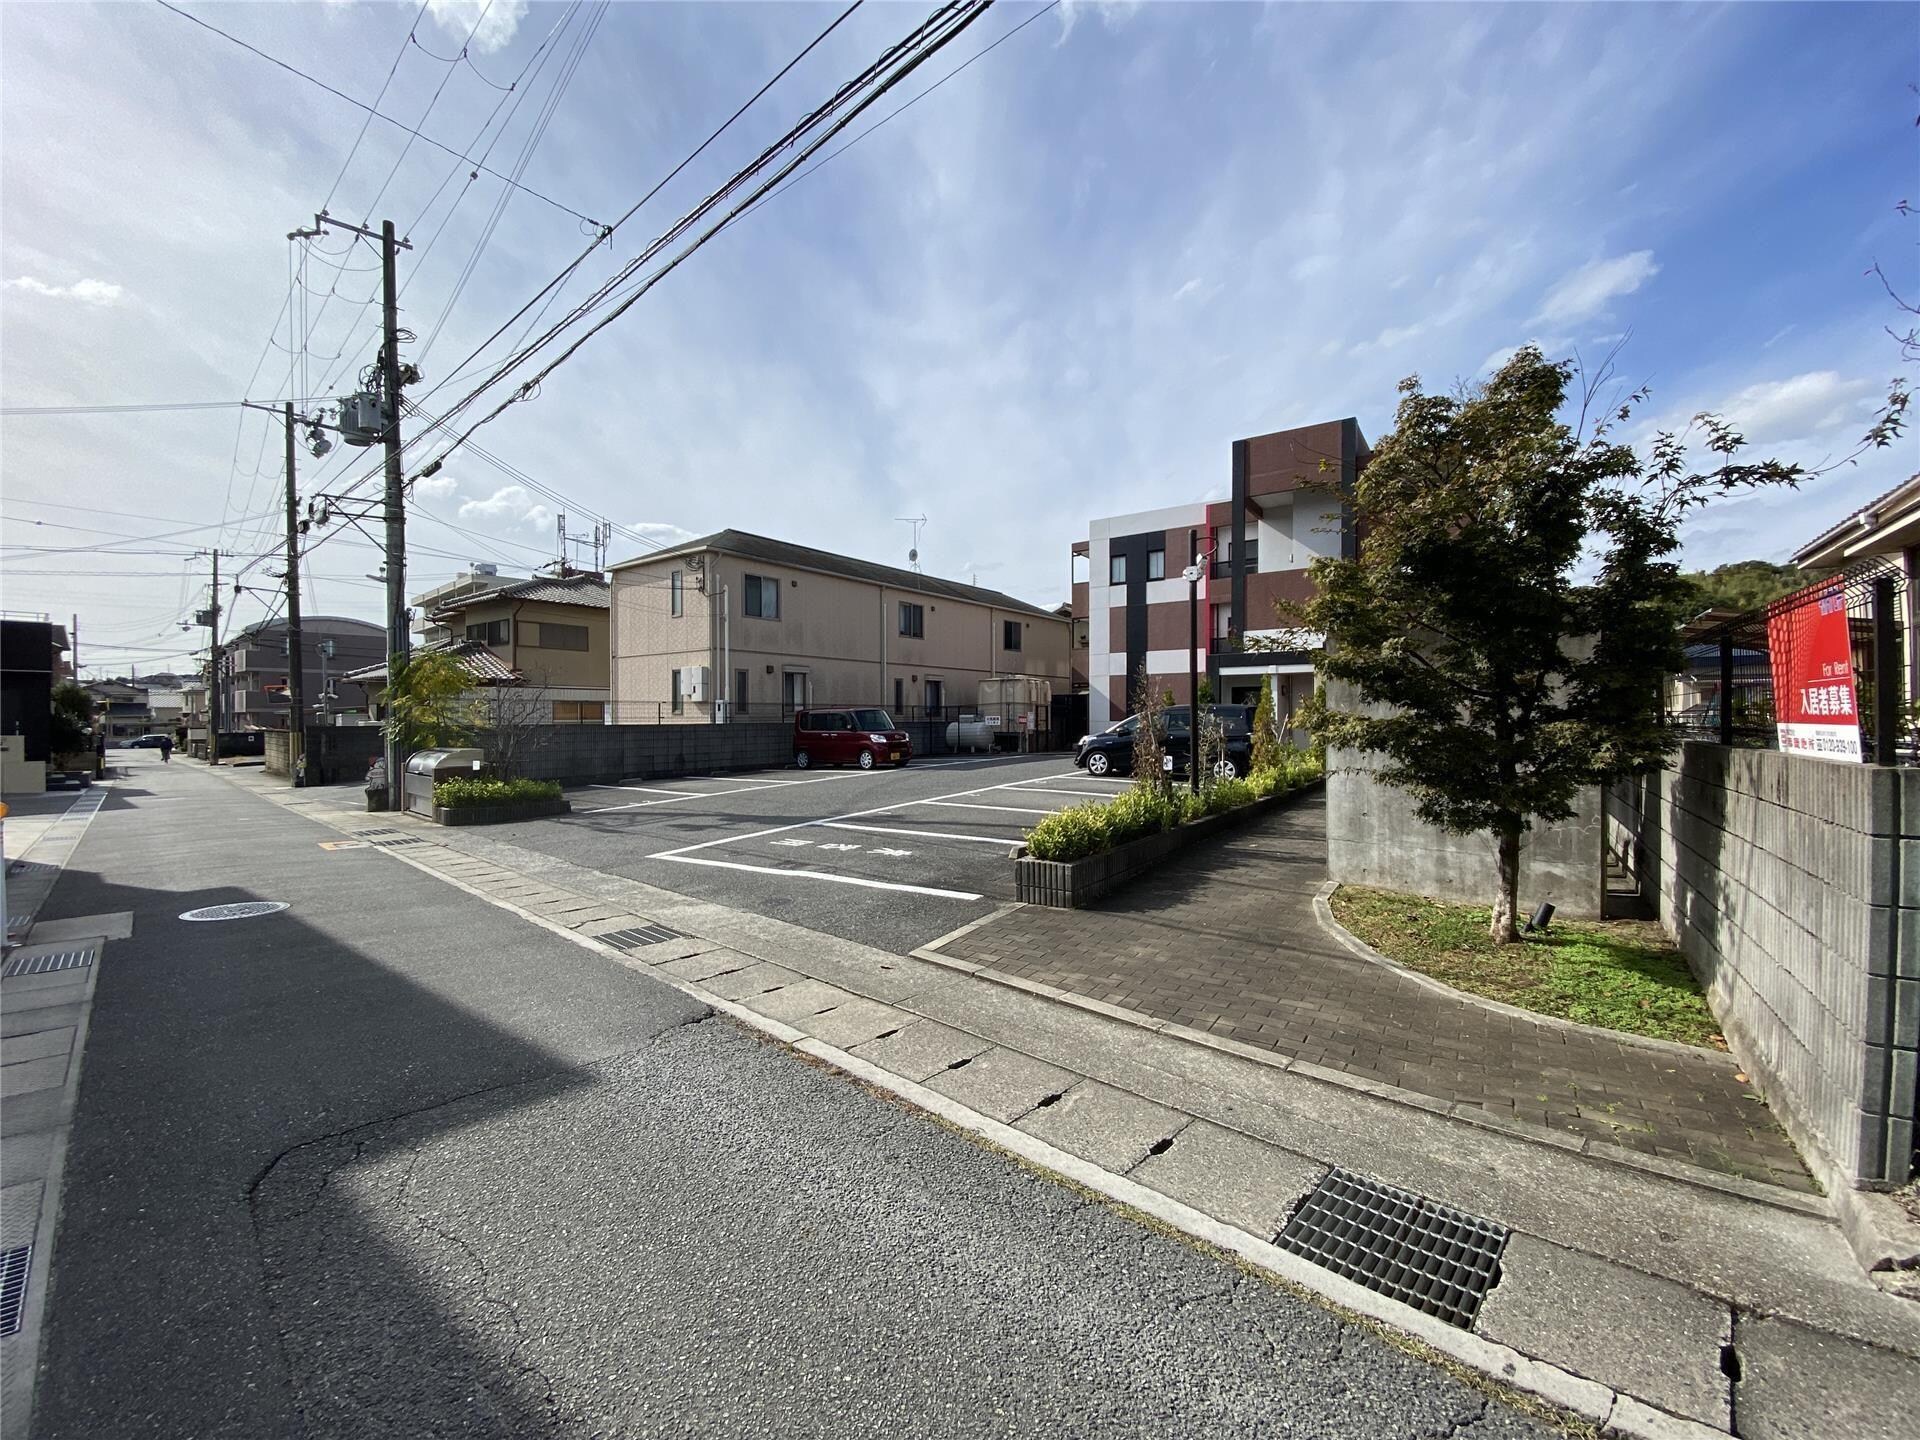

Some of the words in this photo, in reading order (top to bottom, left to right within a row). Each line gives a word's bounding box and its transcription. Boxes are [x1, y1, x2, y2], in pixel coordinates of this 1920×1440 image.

[1822, 663, 1832, 677] For
[1834, 659, 1849, 676] Rent
[1800, 686, 1853, 717] 入居者募集
